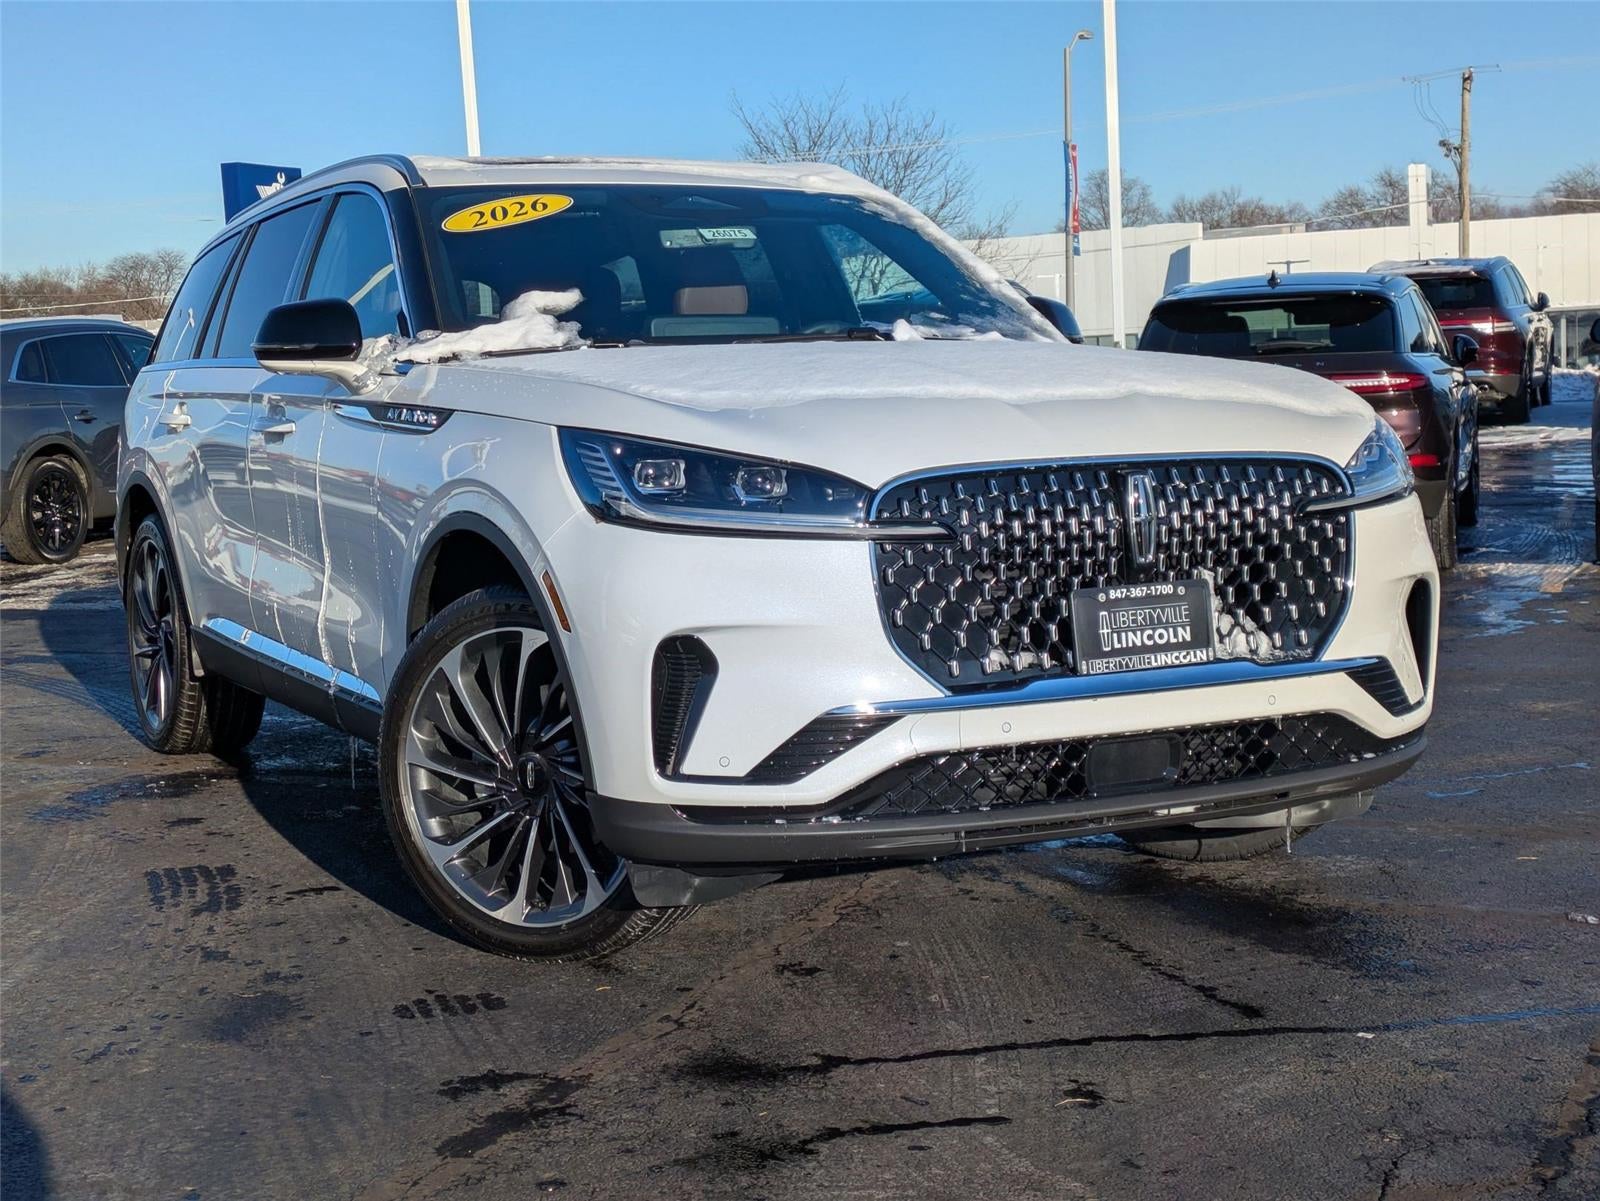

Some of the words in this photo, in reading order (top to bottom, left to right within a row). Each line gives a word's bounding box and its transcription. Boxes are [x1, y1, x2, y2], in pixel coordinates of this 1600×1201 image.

[469, 197, 548, 228] 2026
[708, 229, 748, 238] 26075
[1109, 584, 1173, 599] 847-367-1700
[1111, 606, 1190, 628] LIBERTYVILLE
[1113, 626, 1191, 648] LINCOLN
